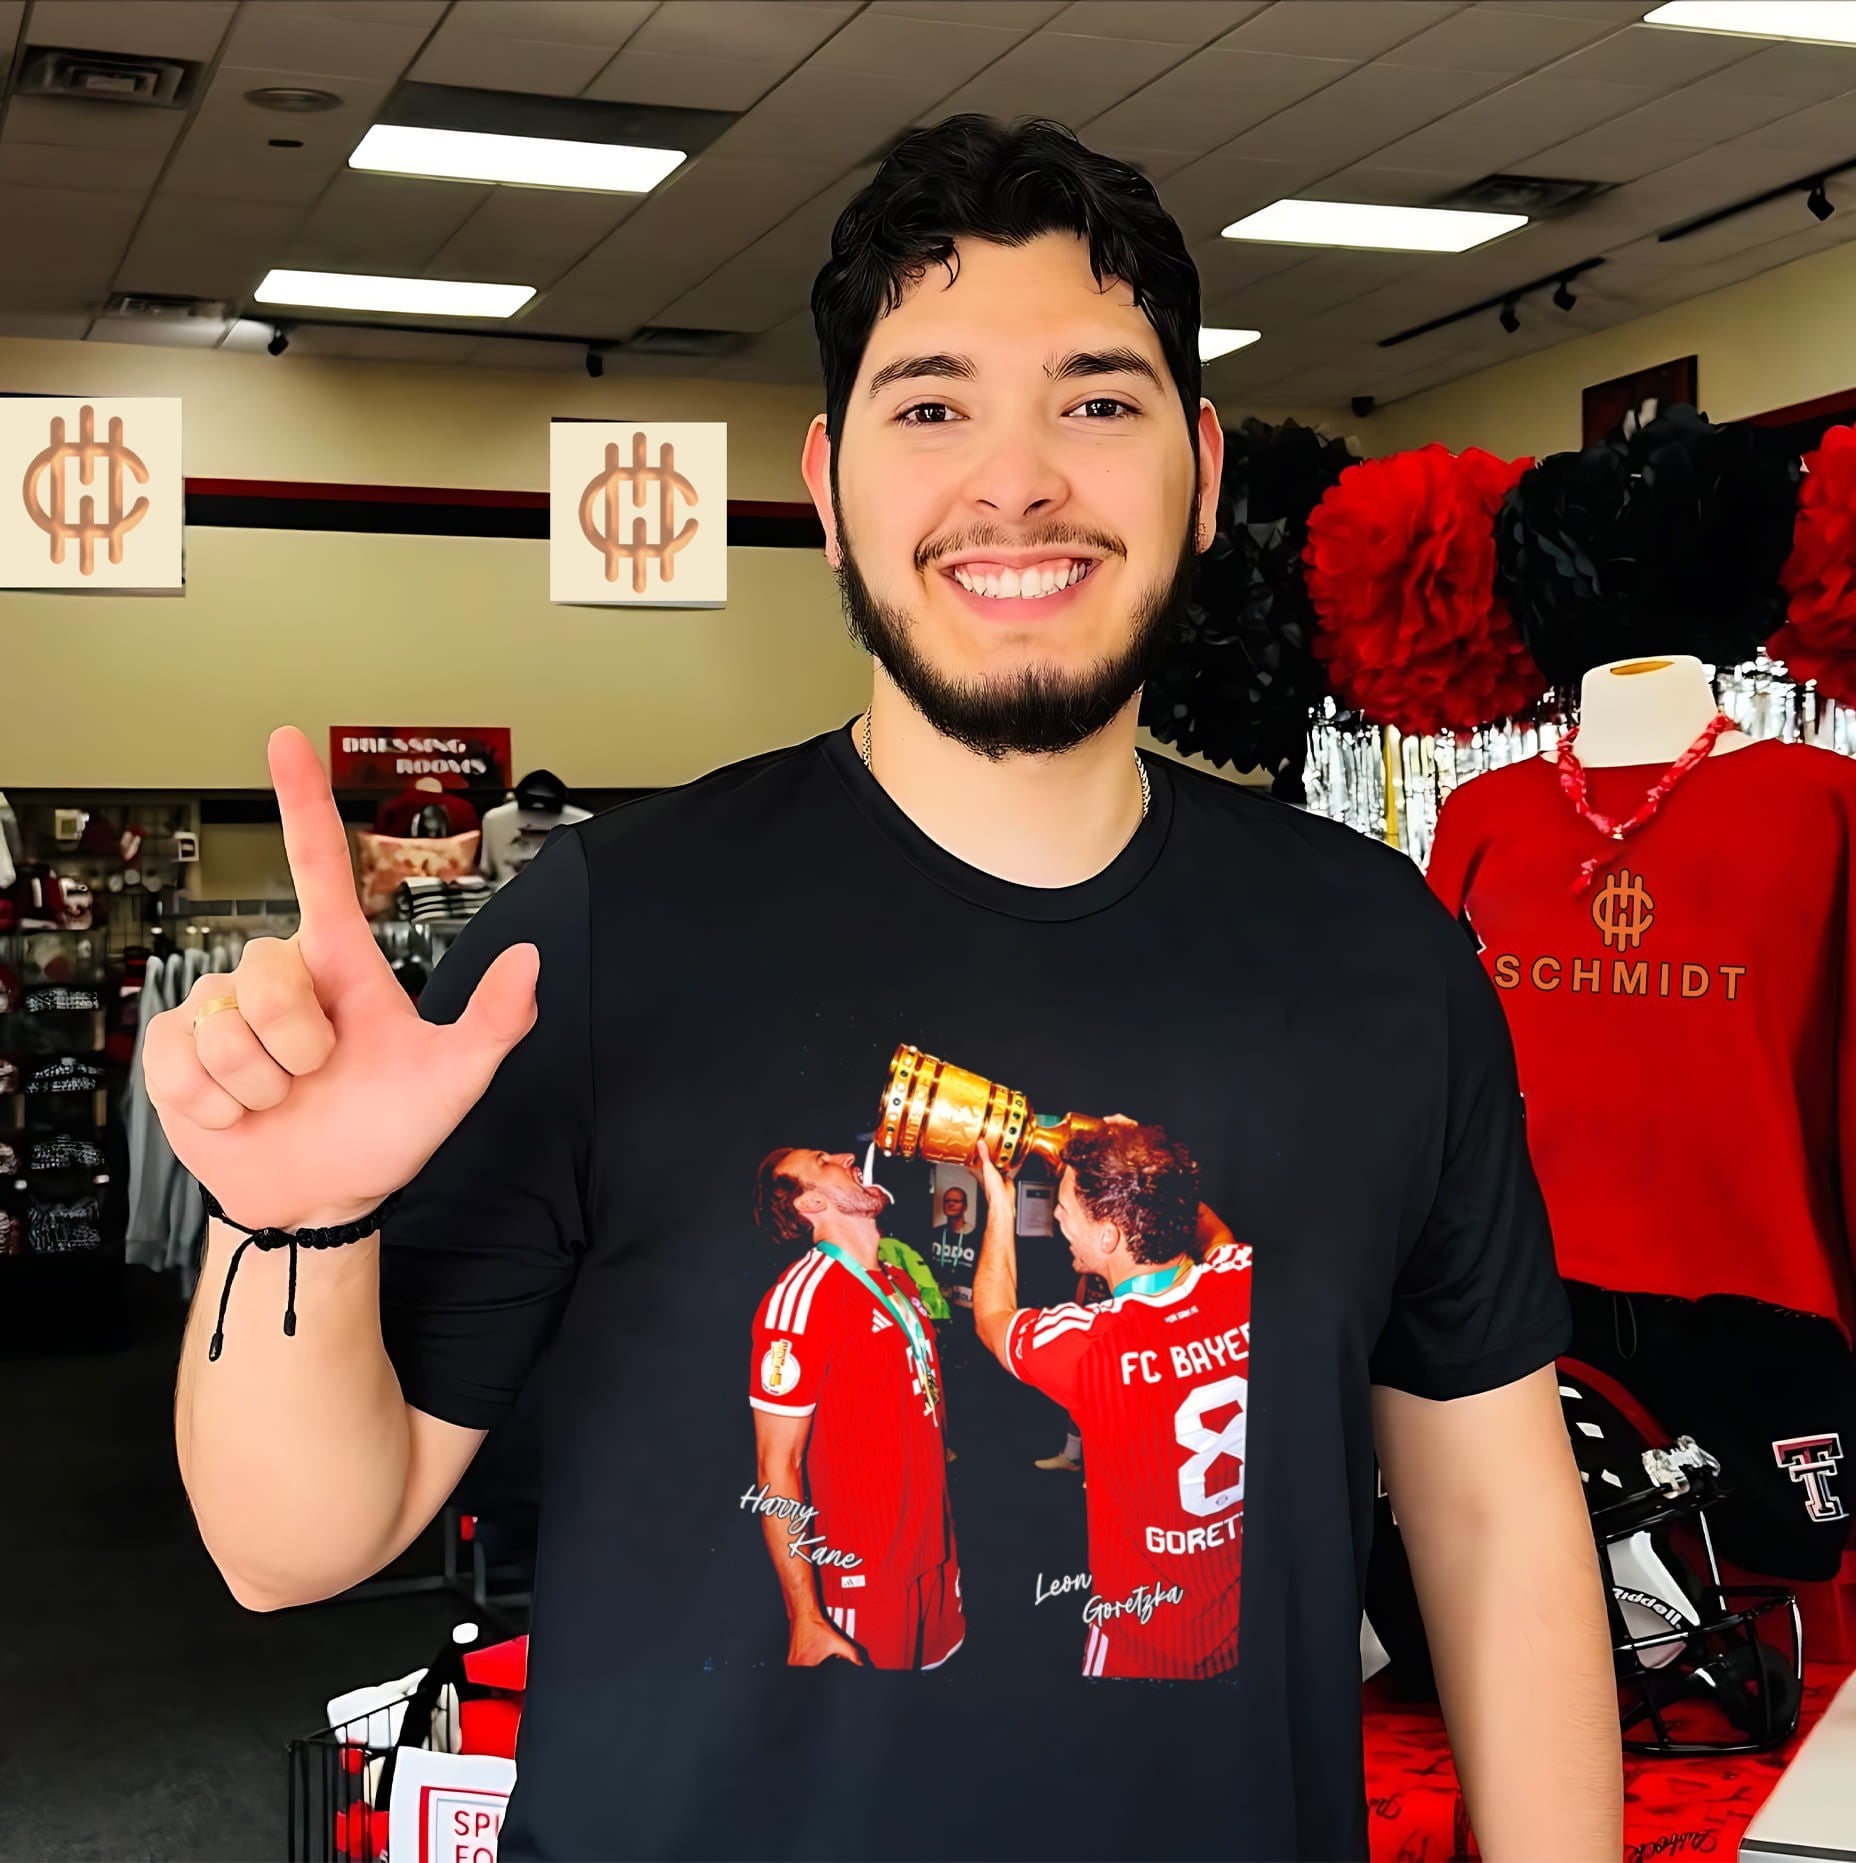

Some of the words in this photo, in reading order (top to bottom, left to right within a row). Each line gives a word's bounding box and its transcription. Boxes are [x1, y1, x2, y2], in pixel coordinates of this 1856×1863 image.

[1494, 954, 1747, 1001] SCHMIDT
[1120, 1349, 1162, 1386] FC
[1174, 1375, 1248, 1517] 8
[739, 1484, 820, 1535] Harry
[788, 1531, 864, 1569] Kane
[1145, 1511, 1244, 1555] GORET
[1034, 1572, 1093, 1606] Leon
[1082, 1581, 1184, 1627] Goretzka
